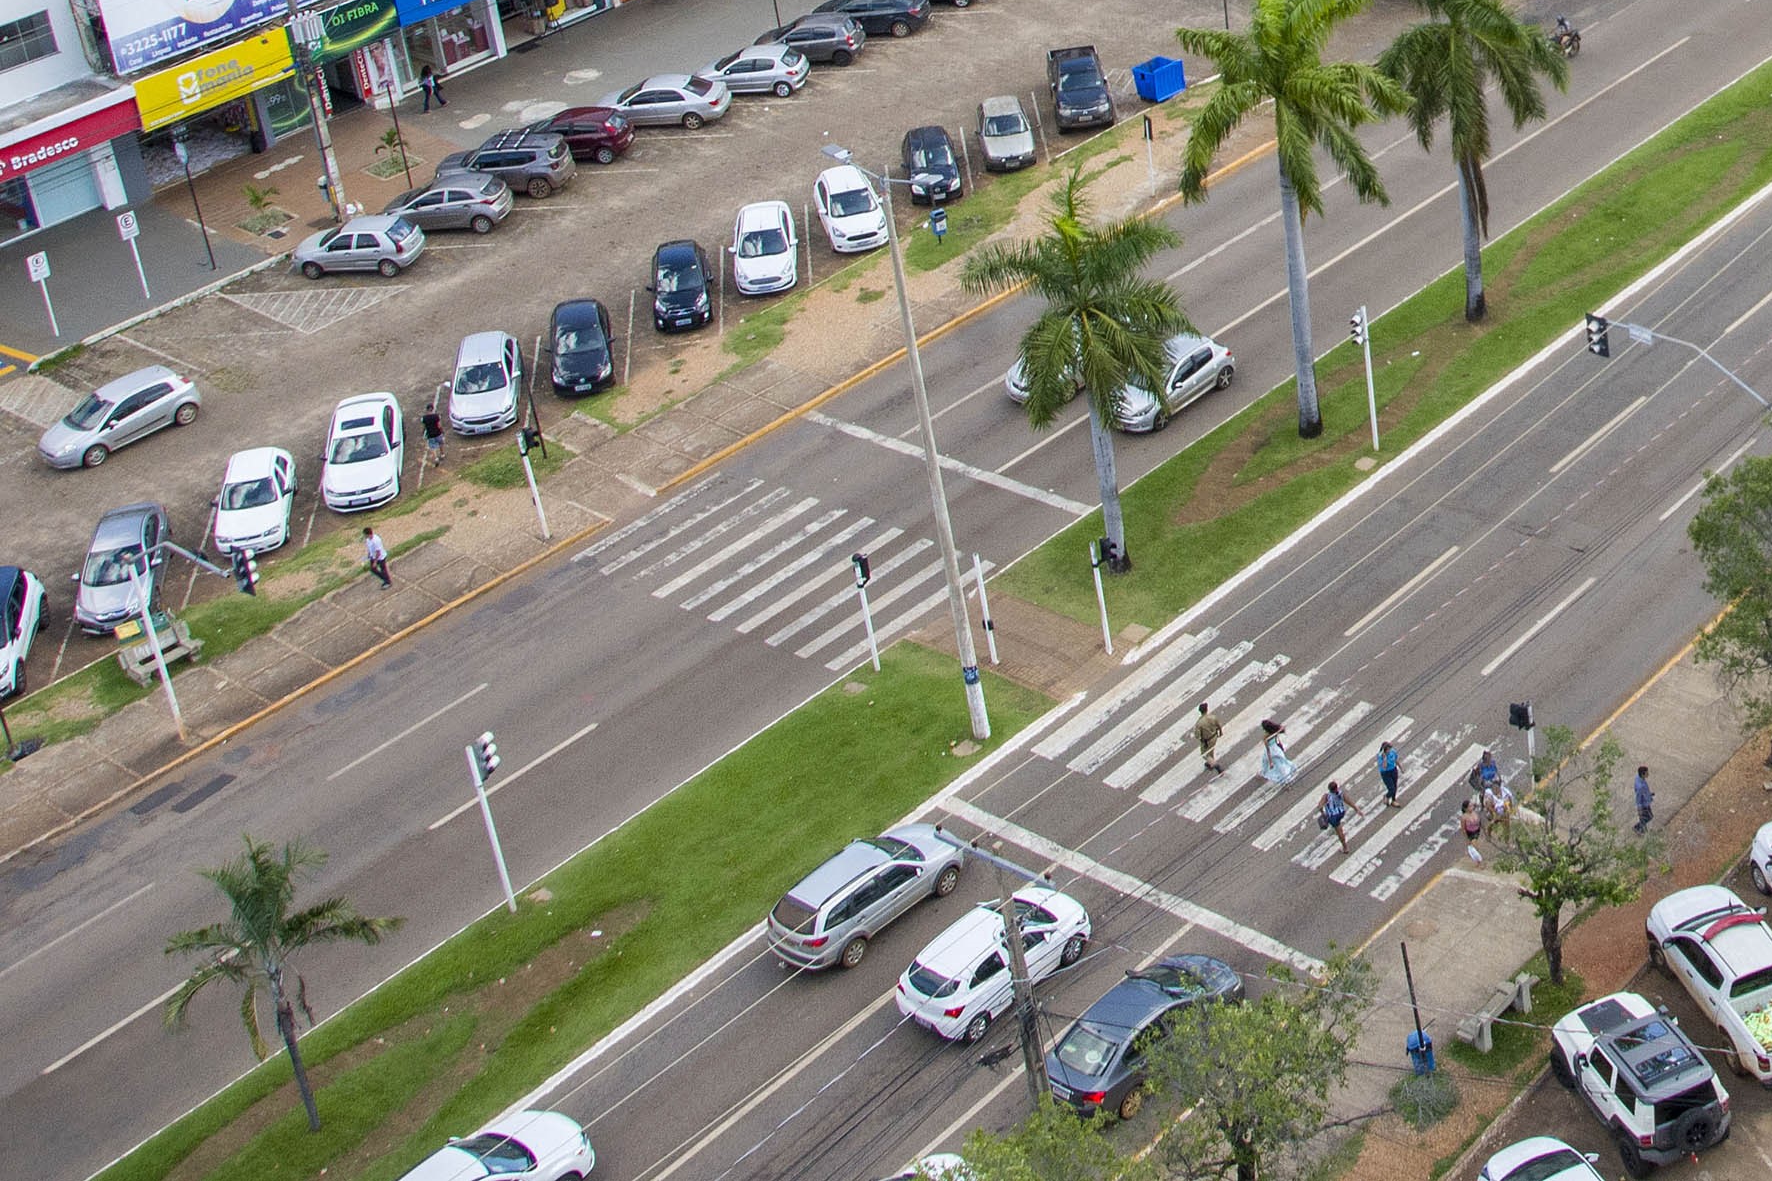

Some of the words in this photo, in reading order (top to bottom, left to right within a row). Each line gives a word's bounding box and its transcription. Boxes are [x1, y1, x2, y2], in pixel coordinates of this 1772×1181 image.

[332, 15, 345, 27] OI
[347, 1, 380, 21] FIBRA
[126, 23, 188, 56] 3225-1177
[196, 58, 240, 81] fone
[10, 136, 79, 171] Bradesco
